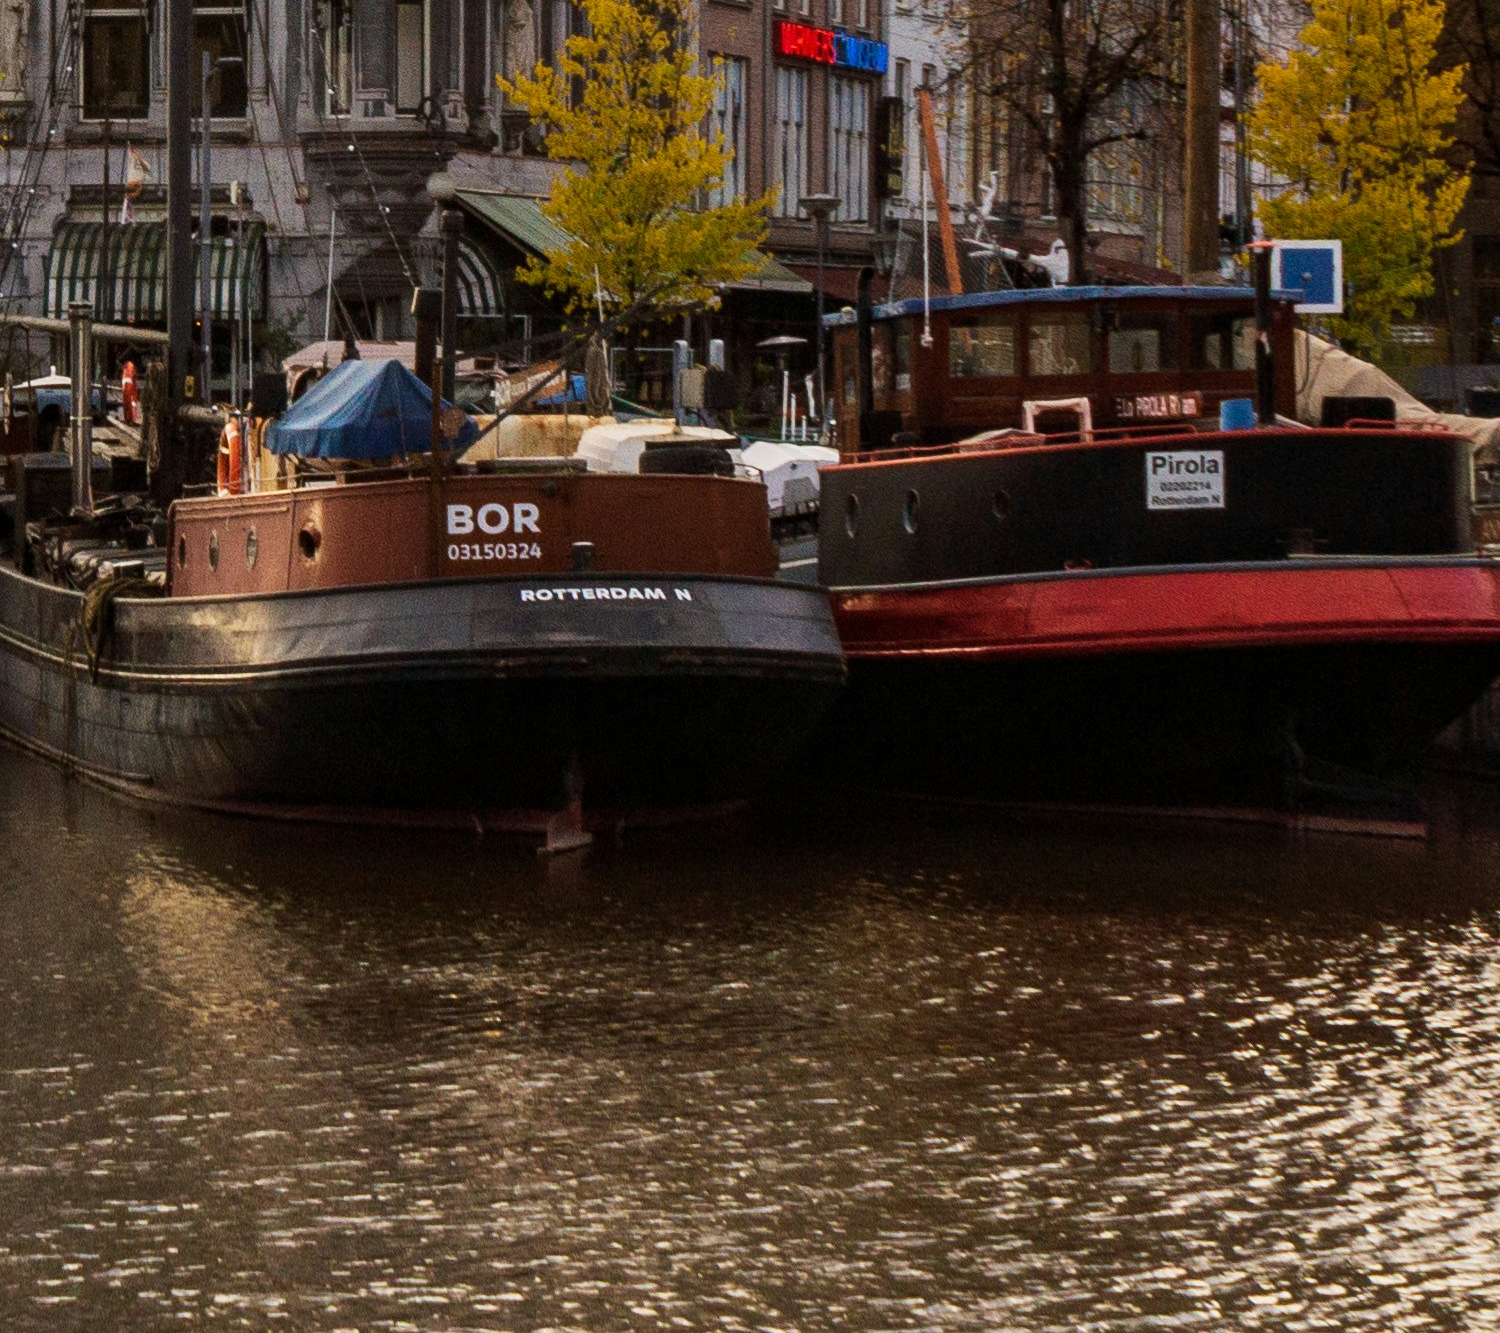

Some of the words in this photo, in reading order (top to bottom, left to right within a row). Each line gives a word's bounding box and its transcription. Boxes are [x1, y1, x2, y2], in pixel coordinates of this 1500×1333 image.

[1151, 454, 1220, 476] Pirola
[446, 502, 542, 535] BOR
[447, 542, 542, 561] 03150324
[520, 587, 667, 603] ROTTERDAM
[674, 588, 693, 602] N
